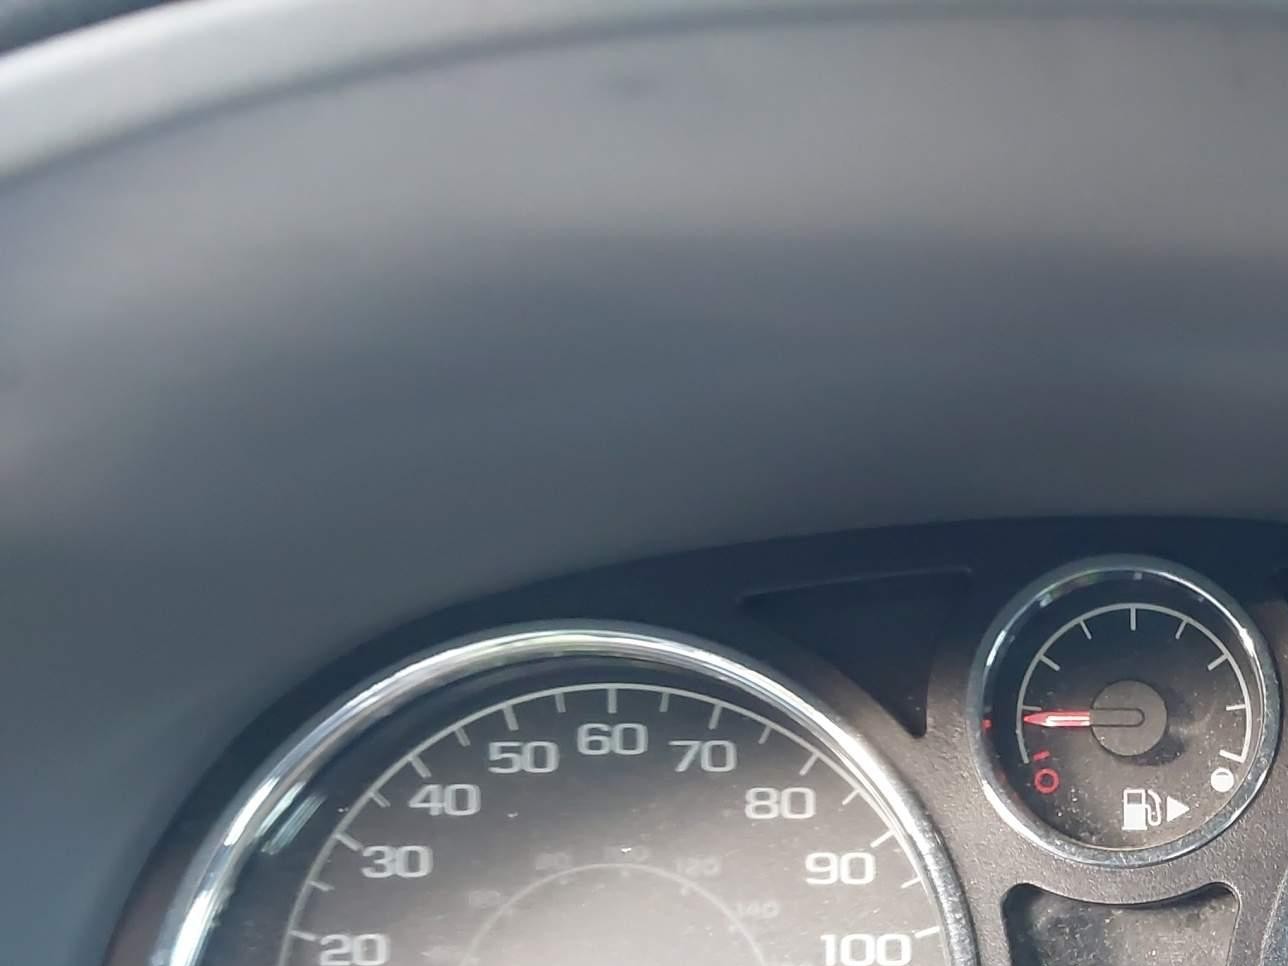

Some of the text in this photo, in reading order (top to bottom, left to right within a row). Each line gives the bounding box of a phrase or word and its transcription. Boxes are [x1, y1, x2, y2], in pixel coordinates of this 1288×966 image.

[577, 723, 648, 755] 60
[489, 741, 560, 773] 50
[669, 740, 737, 773] 70
[409, 784, 481, 816] 40
[745, 787, 816, 820] 80
[361, 845, 433, 878] 30
[805, 852, 876, 885] 90
[320, 934, 390, 966] 20
[820, 934, 912, 966] 100
